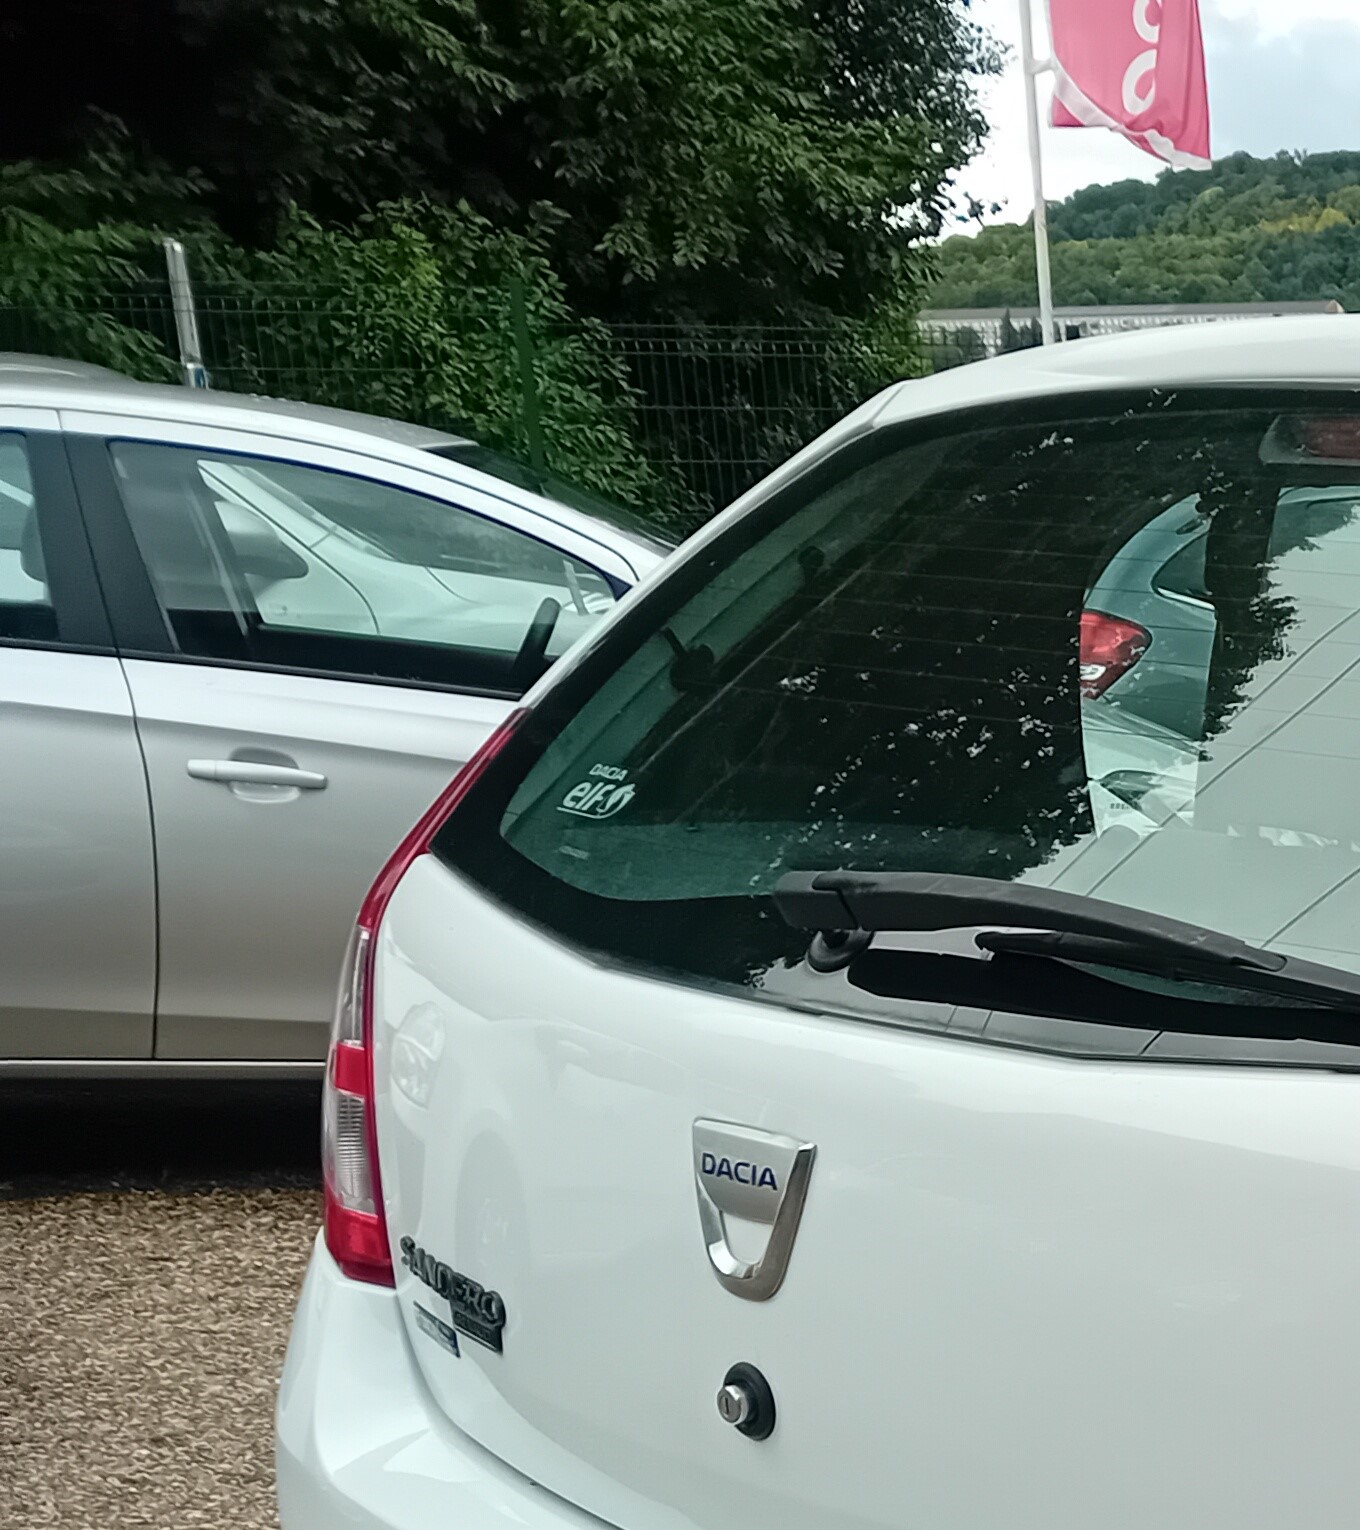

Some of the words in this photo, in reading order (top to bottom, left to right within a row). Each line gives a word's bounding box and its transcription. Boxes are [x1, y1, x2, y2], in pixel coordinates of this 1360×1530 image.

[589, 763, 629, 781] DACIA
[701, 1151, 778, 1192] DACIA
[399, 1234, 507, 1330] SANDERO
